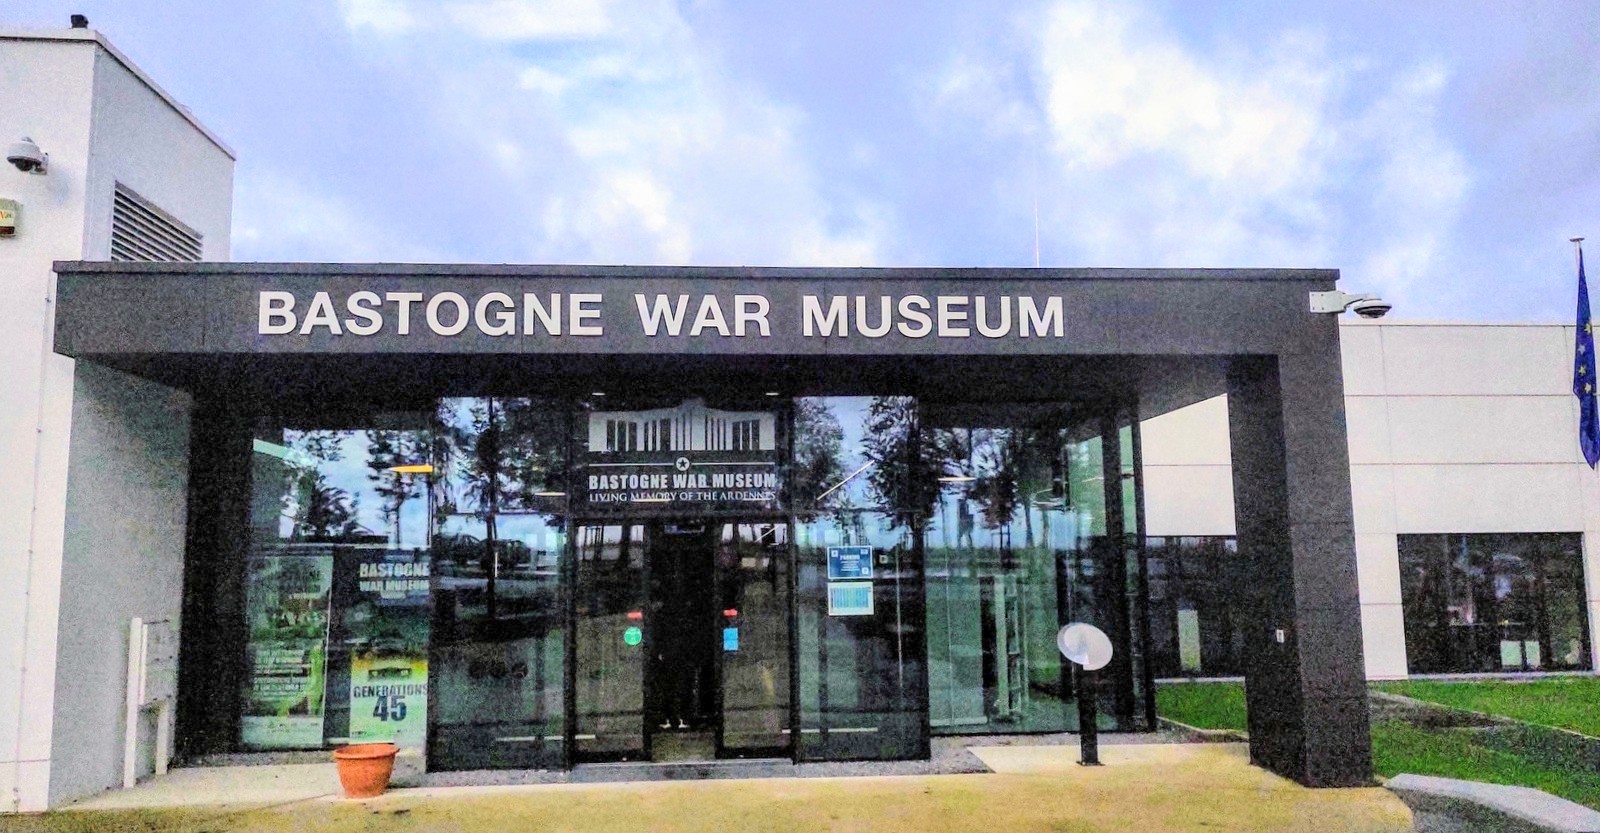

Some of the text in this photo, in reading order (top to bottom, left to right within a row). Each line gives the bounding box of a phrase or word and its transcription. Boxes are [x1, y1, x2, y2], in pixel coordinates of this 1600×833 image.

[257, 291, 1065, 339] BASTOGNE WAR MUSEUM
[589, 473, 776, 490] BASTOGNE WAR MUSEUM
[590, 490, 776, 502] LIVING MEMORY OF THE ARDENNES
[359, 562, 430, 577] BASTOGNE
[359, 580, 430, 592] WAR MUSEUM
[353, 683, 428, 698] GENERATIONS
[373, 695, 407, 722] 45
